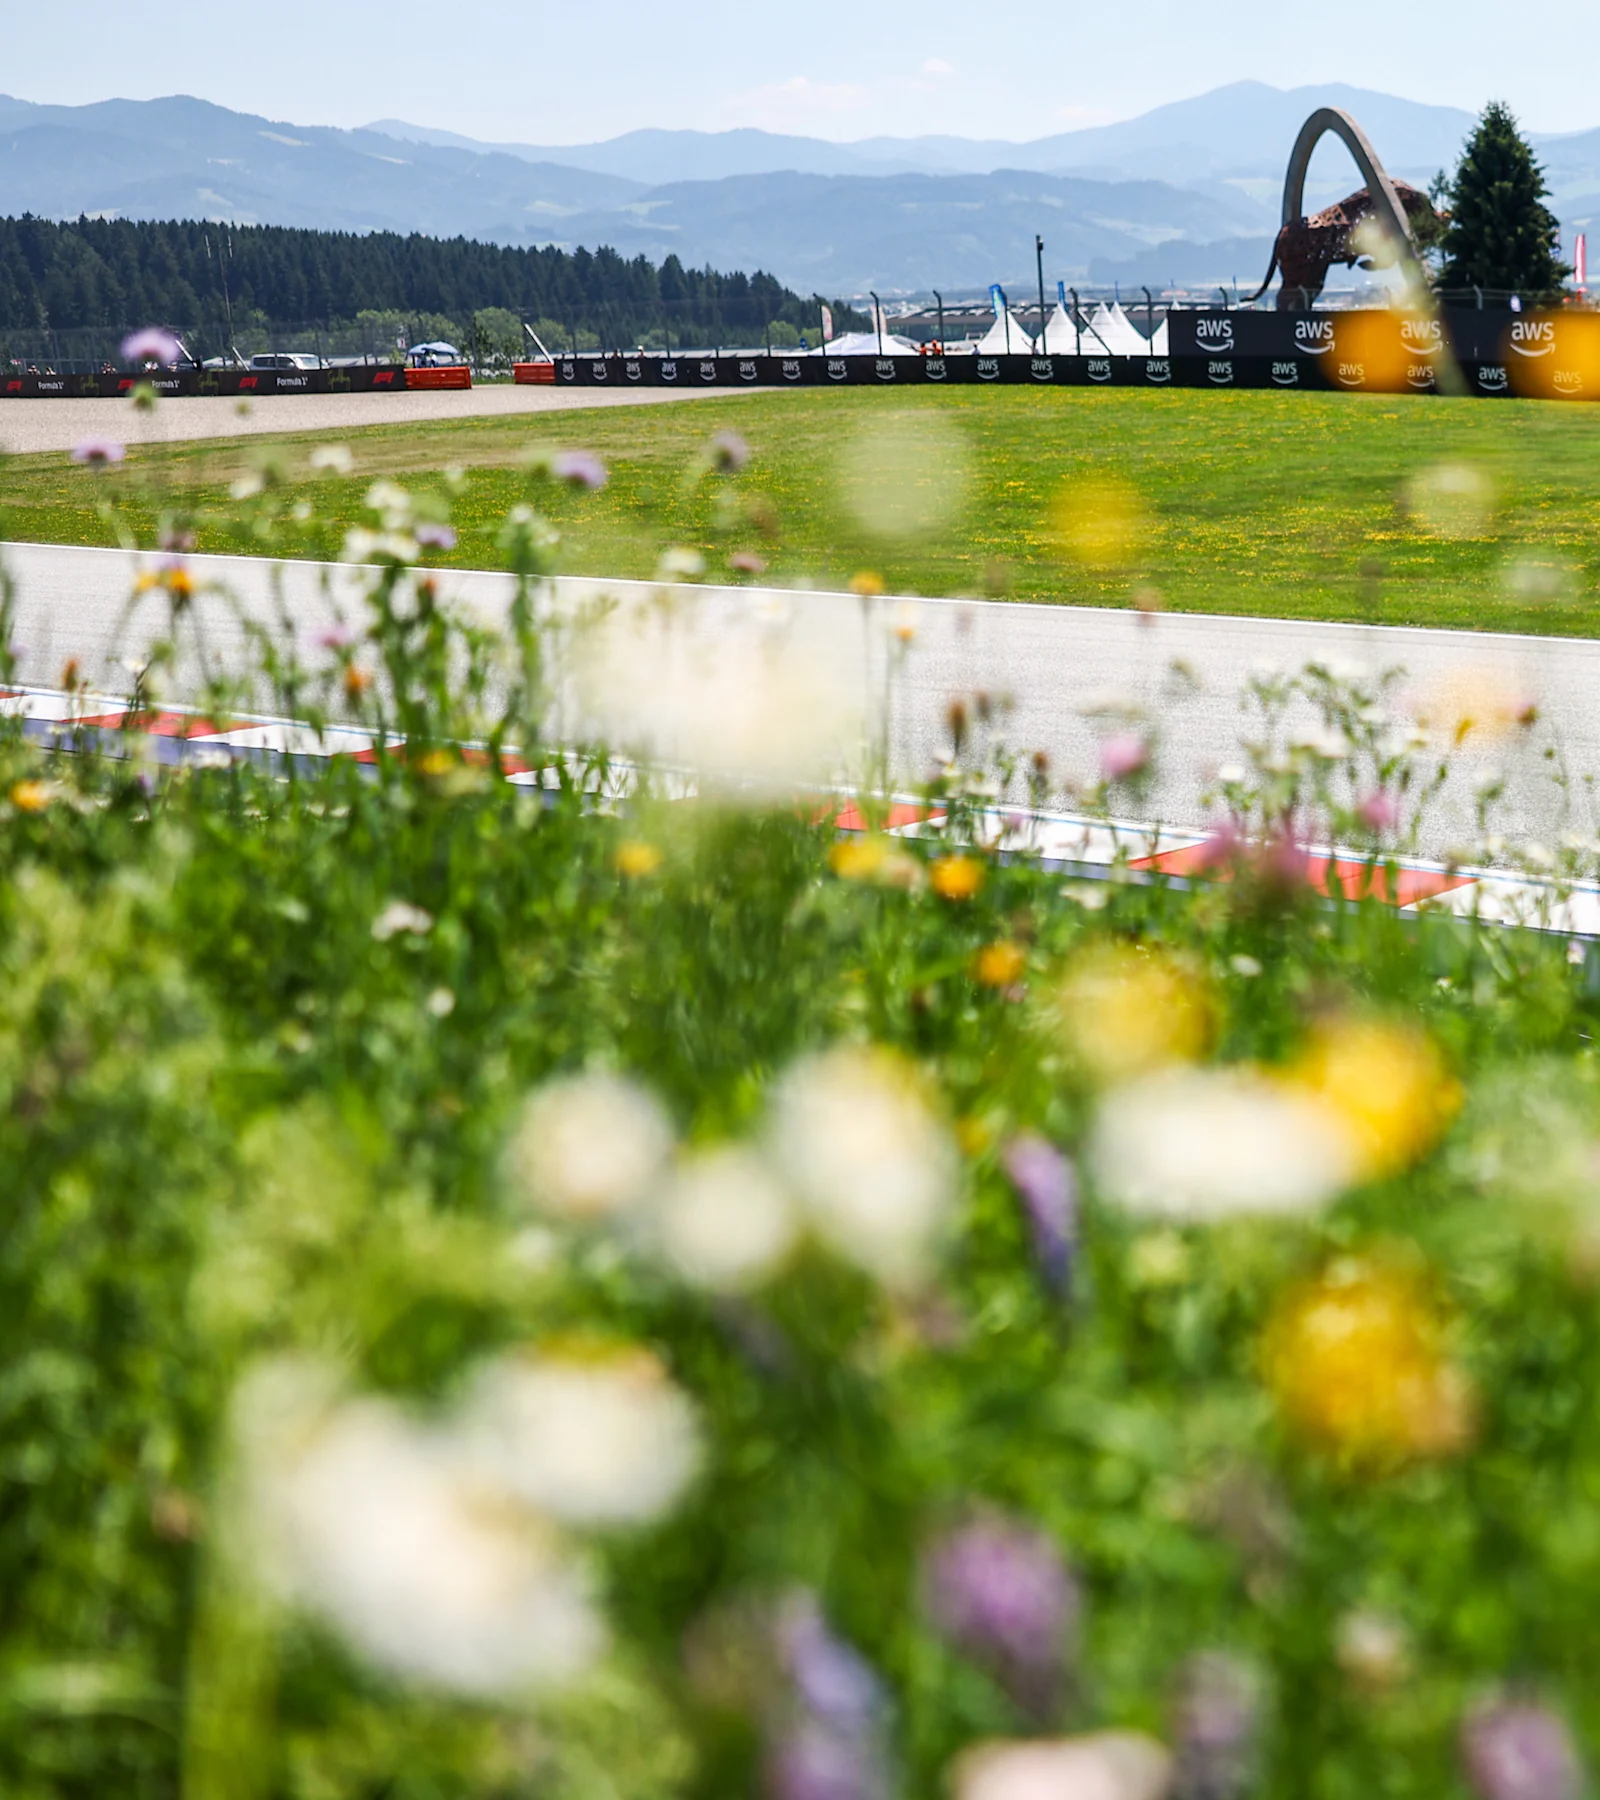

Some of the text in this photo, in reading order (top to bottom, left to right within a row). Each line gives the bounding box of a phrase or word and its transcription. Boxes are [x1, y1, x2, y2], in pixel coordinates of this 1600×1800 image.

[1197, 319, 1232, 338] aws
[1295, 321, 1333, 340] aws
[1401, 320, 1442, 339] aws
[1511, 322, 1554, 342] aws
[1208, 361, 1233, 374] aws
[1272, 362, 1297, 375] aws
[1339, 363, 1365, 376] aws
[1408, 364, 1433, 378] aws
[1479, 366, 1506, 381] aws
[277, 377, 301, 386] Formula
[1554, 370, 1581, 384] aws
